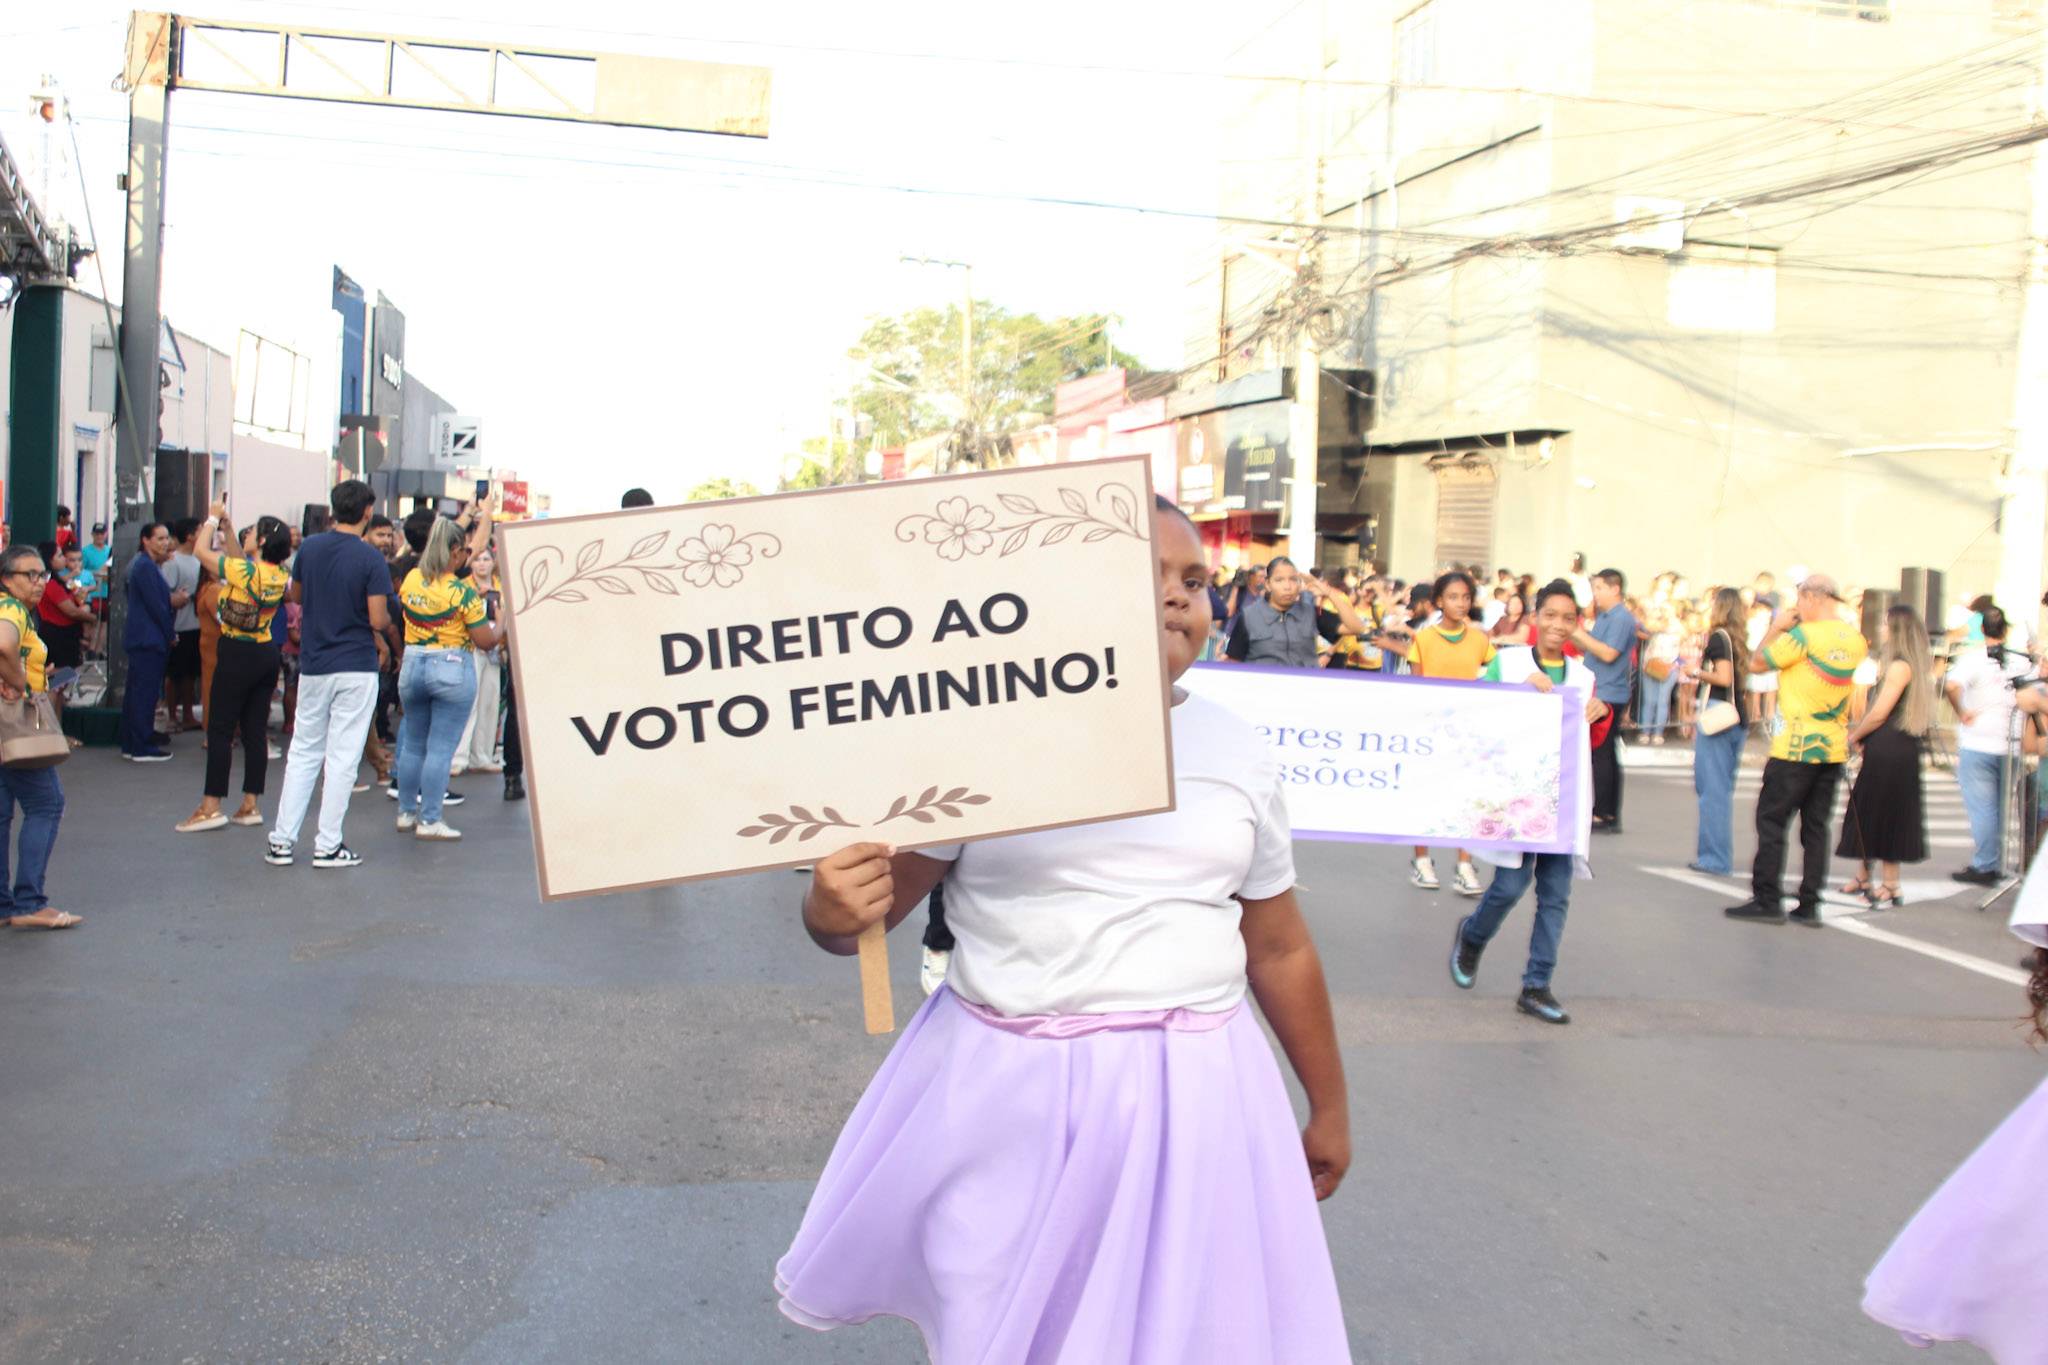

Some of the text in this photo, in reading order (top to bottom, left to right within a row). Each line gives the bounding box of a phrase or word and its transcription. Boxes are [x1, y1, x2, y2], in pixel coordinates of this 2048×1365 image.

[661, 592, 1028, 676] DIREITO AO
[570, 646, 1119, 756] VOTO FEMININO!
[1358, 731, 1435, 757] nas
